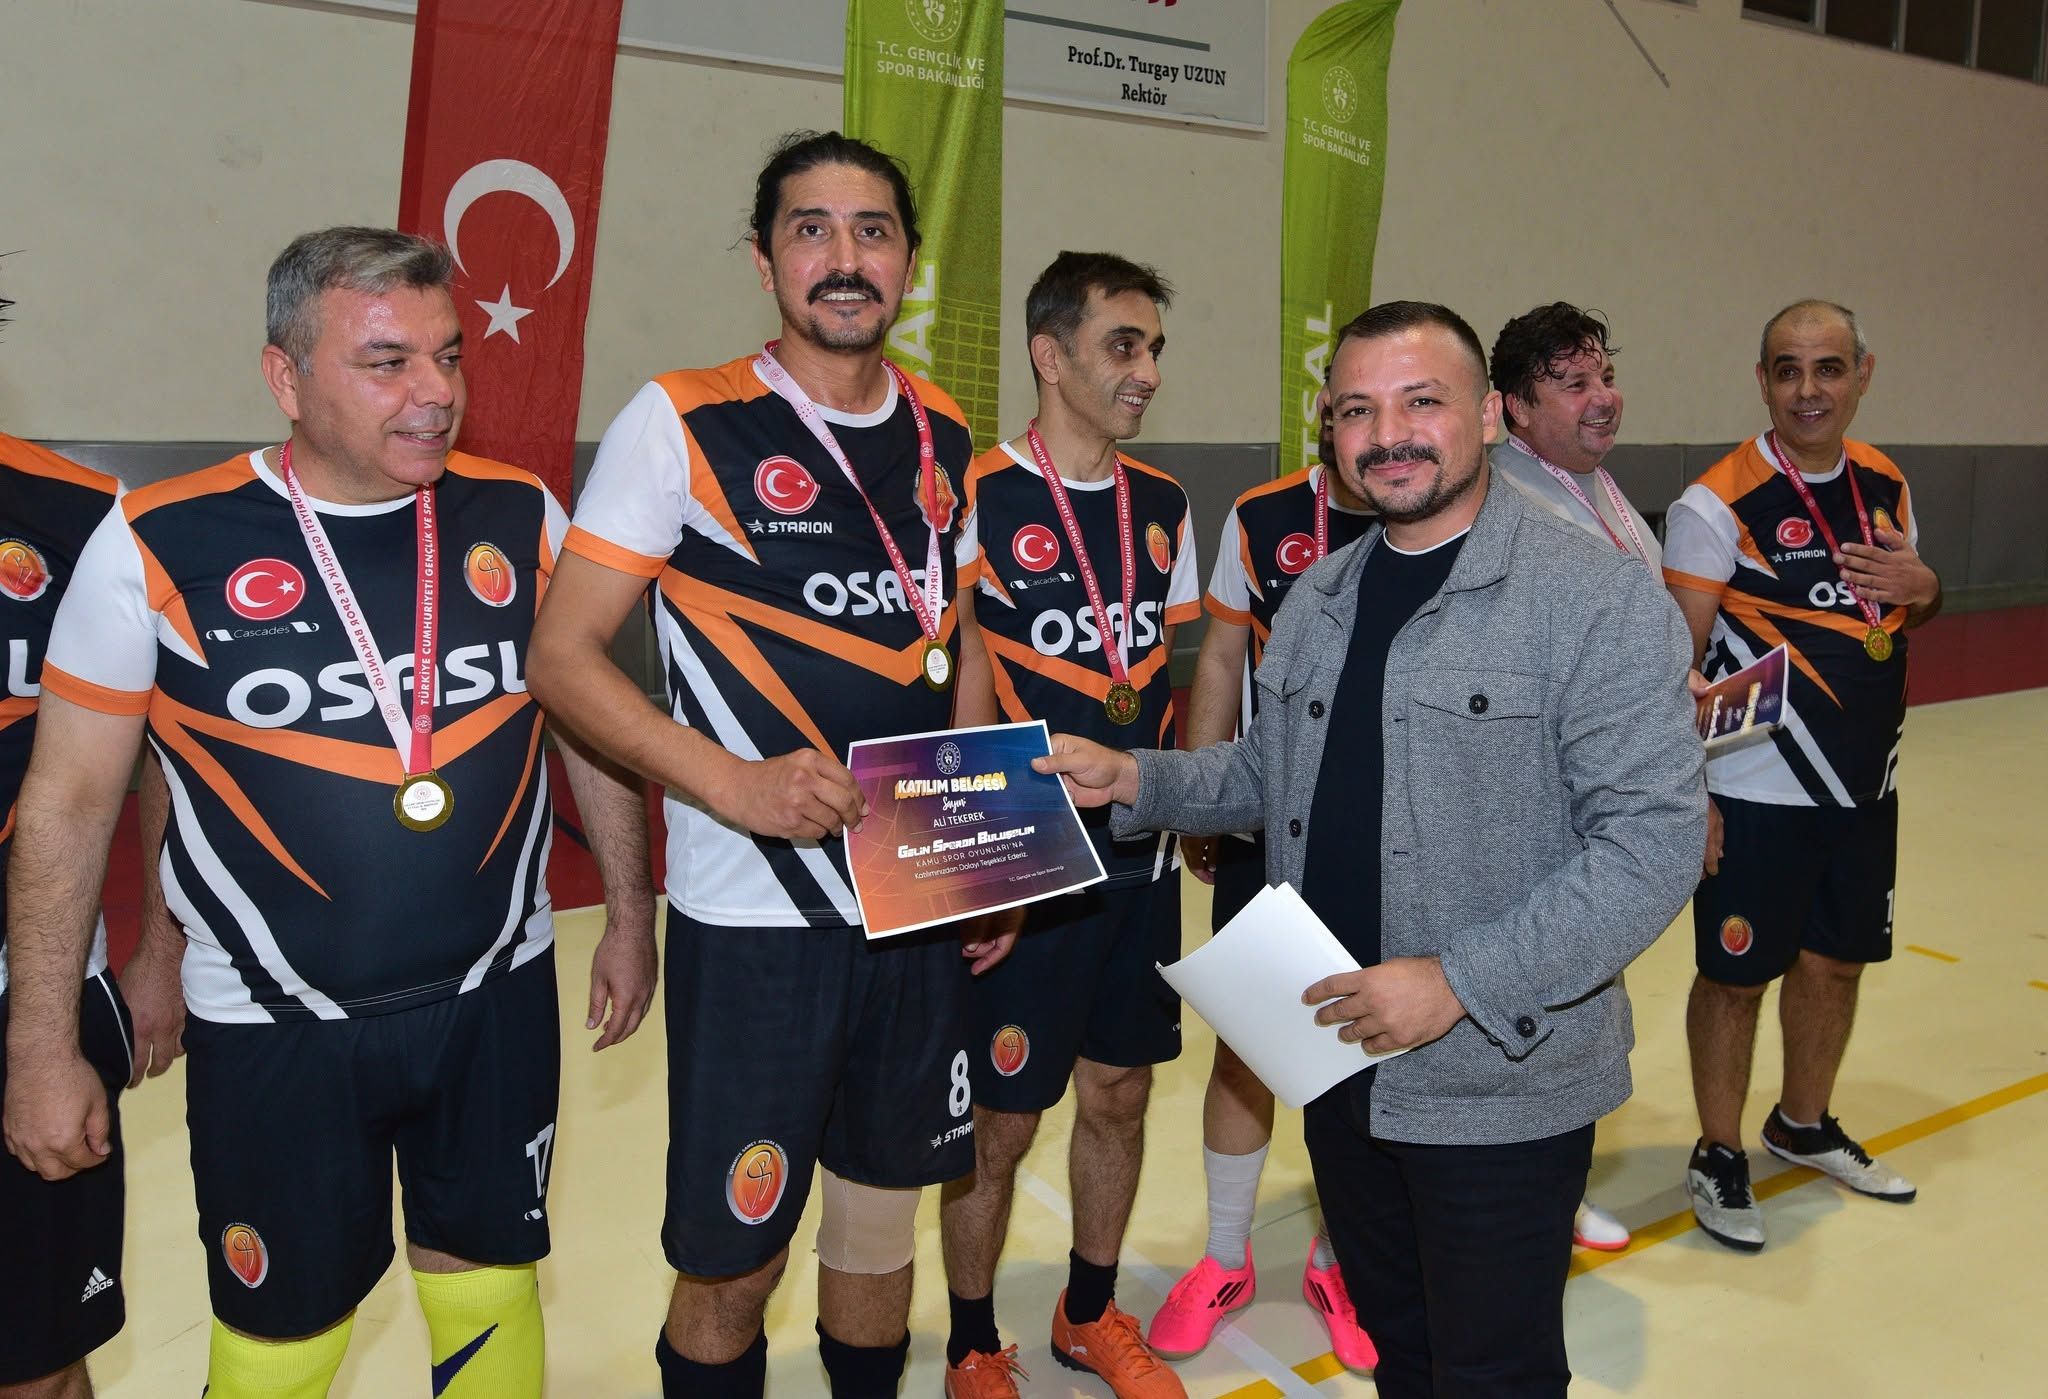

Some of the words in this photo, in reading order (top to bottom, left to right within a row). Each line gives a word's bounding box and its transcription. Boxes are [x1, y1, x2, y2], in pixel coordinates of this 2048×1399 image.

[877, 40, 903, 57] T.C.
[907, 46, 961, 70] GENÇLİK
[966, 58, 985, 72] VE
[1068, 45, 1126, 71] Prof.Dr.
[1128, 55, 1179, 83] Turgay
[1184, 64, 1227, 86] UZUN
[877, 60, 915, 78] SPOR
[918, 66, 985, 90] BAKANLIĞI
[1121, 82, 1168, 106] Rektör
[1303, 117, 1319, 133] T.C.
[1321, 124, 1357, 147] GENÇLİK
[1359, 138, 1371, 152] VE
[1302, 133, 1326, 150] SPOR
[1327, 141, 1370, 166] BAKANLIĞI
[1030, 434, 1048, 465] TÜRKİYE
[423, 490, 432, 515] SPOR
[424, 517, 433, 530] VE
[767, 521, 833, 534] STARION
[422, 531, 435, 577] GENÇLİK
[889, 542, 897, 555] VE
[1785, 548, 1826, 561] STARION
[1081, 557, 1088, 568] VE
[1026, 576, 1060, 587] Cascades
[1084, 569, 1096, 592] SPOR
[421, 579, 434, 655] CUMHURİYETİ
[233, 626, 290, 639] Cascades
[418, 658, 431, 705] TÜRKİYE
[896, 779, 949, 797] KATILIM
[933, 816, 947, 828] ALİ
[947, 811, 986, 826] TEKEREK
[915, 858, 940, 868] KAMU
[943, 853, 965, 862] SPOR
[948, 1049, 971, 1117] 8
[944, 1119, 975, 1143] STAR
[81, 1278, 114, 1303] adidas
